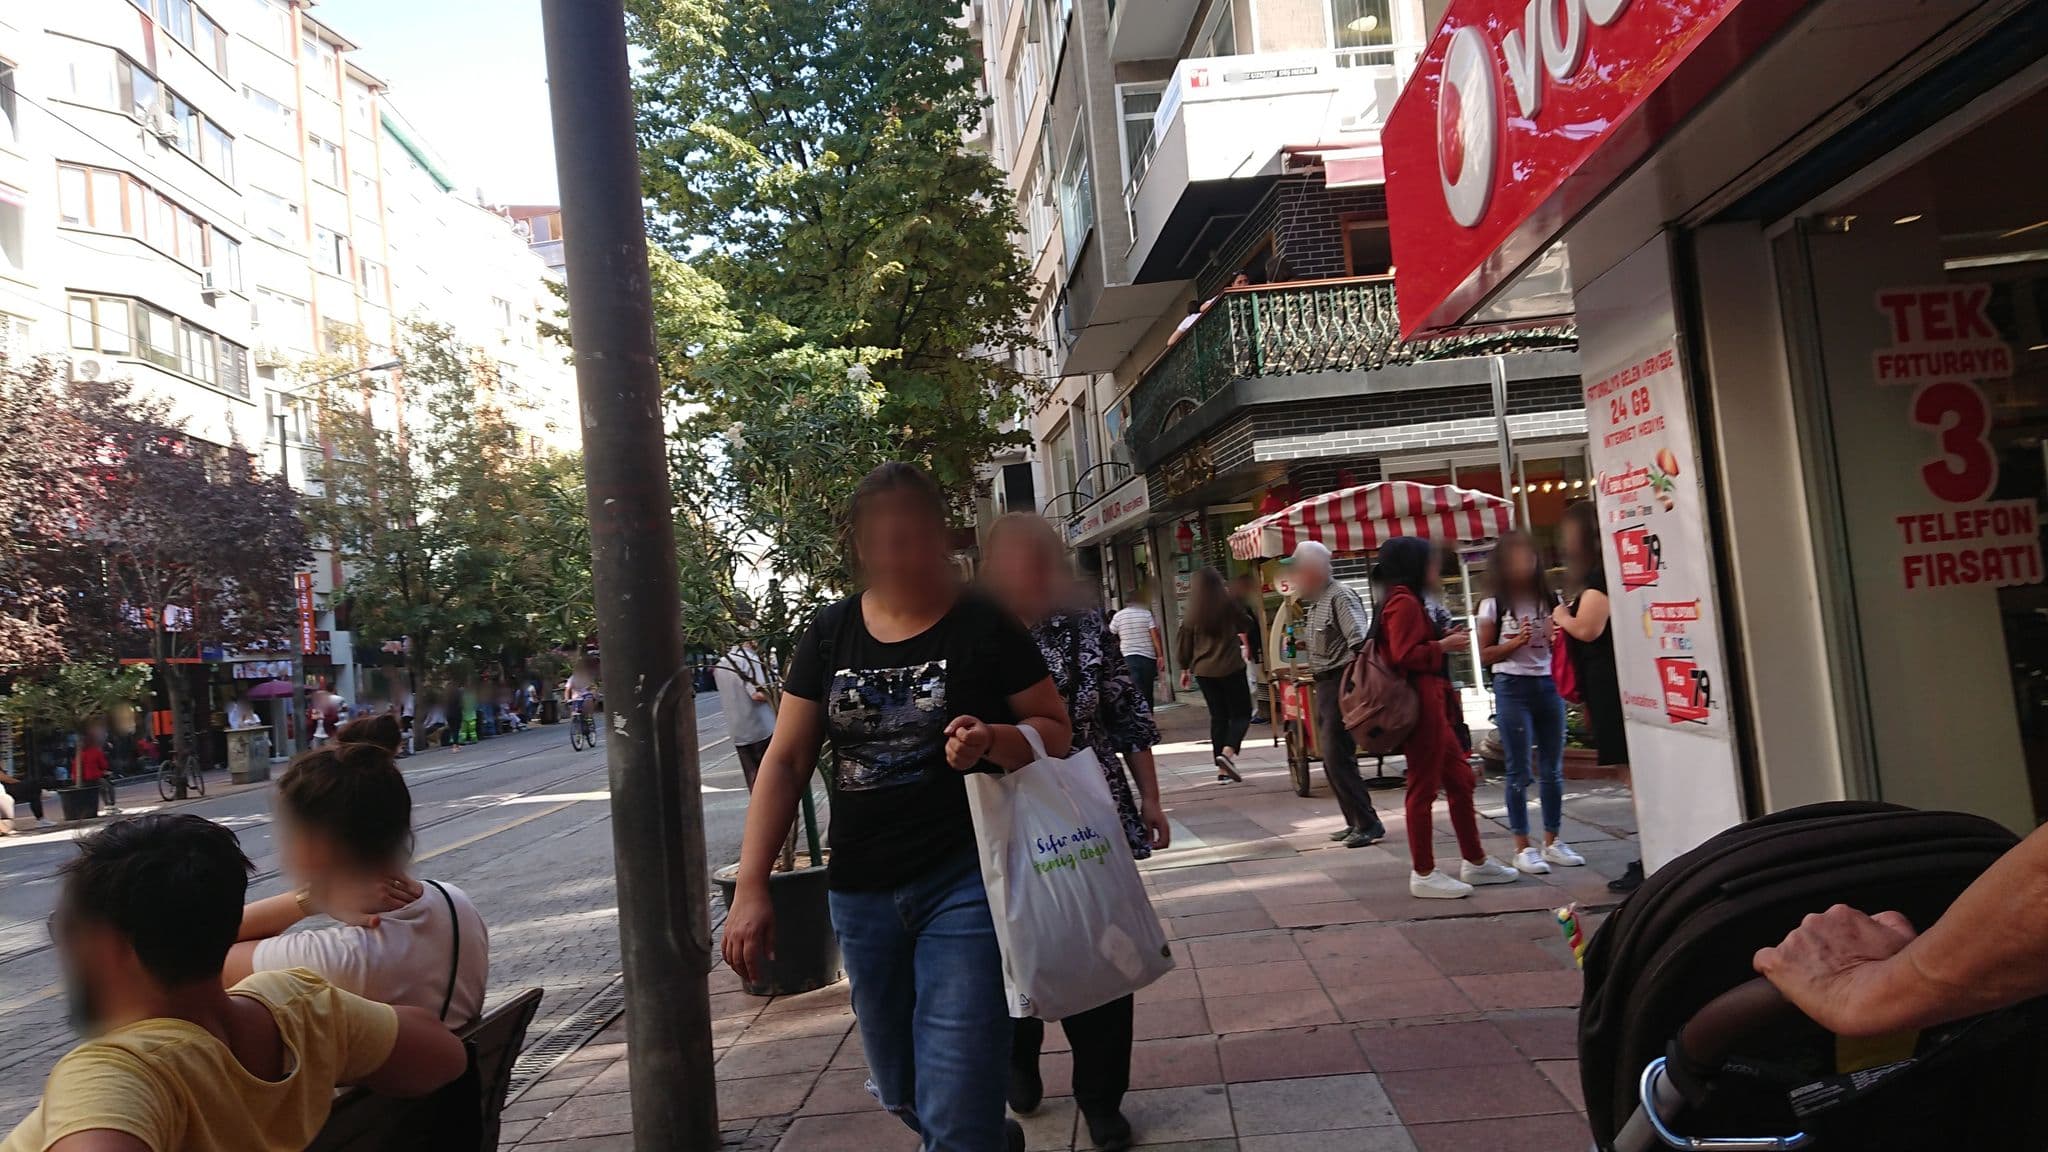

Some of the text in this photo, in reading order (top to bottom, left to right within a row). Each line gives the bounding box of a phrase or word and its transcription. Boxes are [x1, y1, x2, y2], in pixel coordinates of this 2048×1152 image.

[1502, 0, 1632, 119] vo
[1880, 288, 1994, 344] TEK
[1877, 348, 2009, 379] FATURAYA
[1610, 385, 1650, 425] 24 GB
[1914, 381, 1994, 503] 3
[1896, 506, 2033, 545] TELEFON
[1280, 580, 1289, 592] 5
[1903, 545, 2039, 589] FIRSATI
